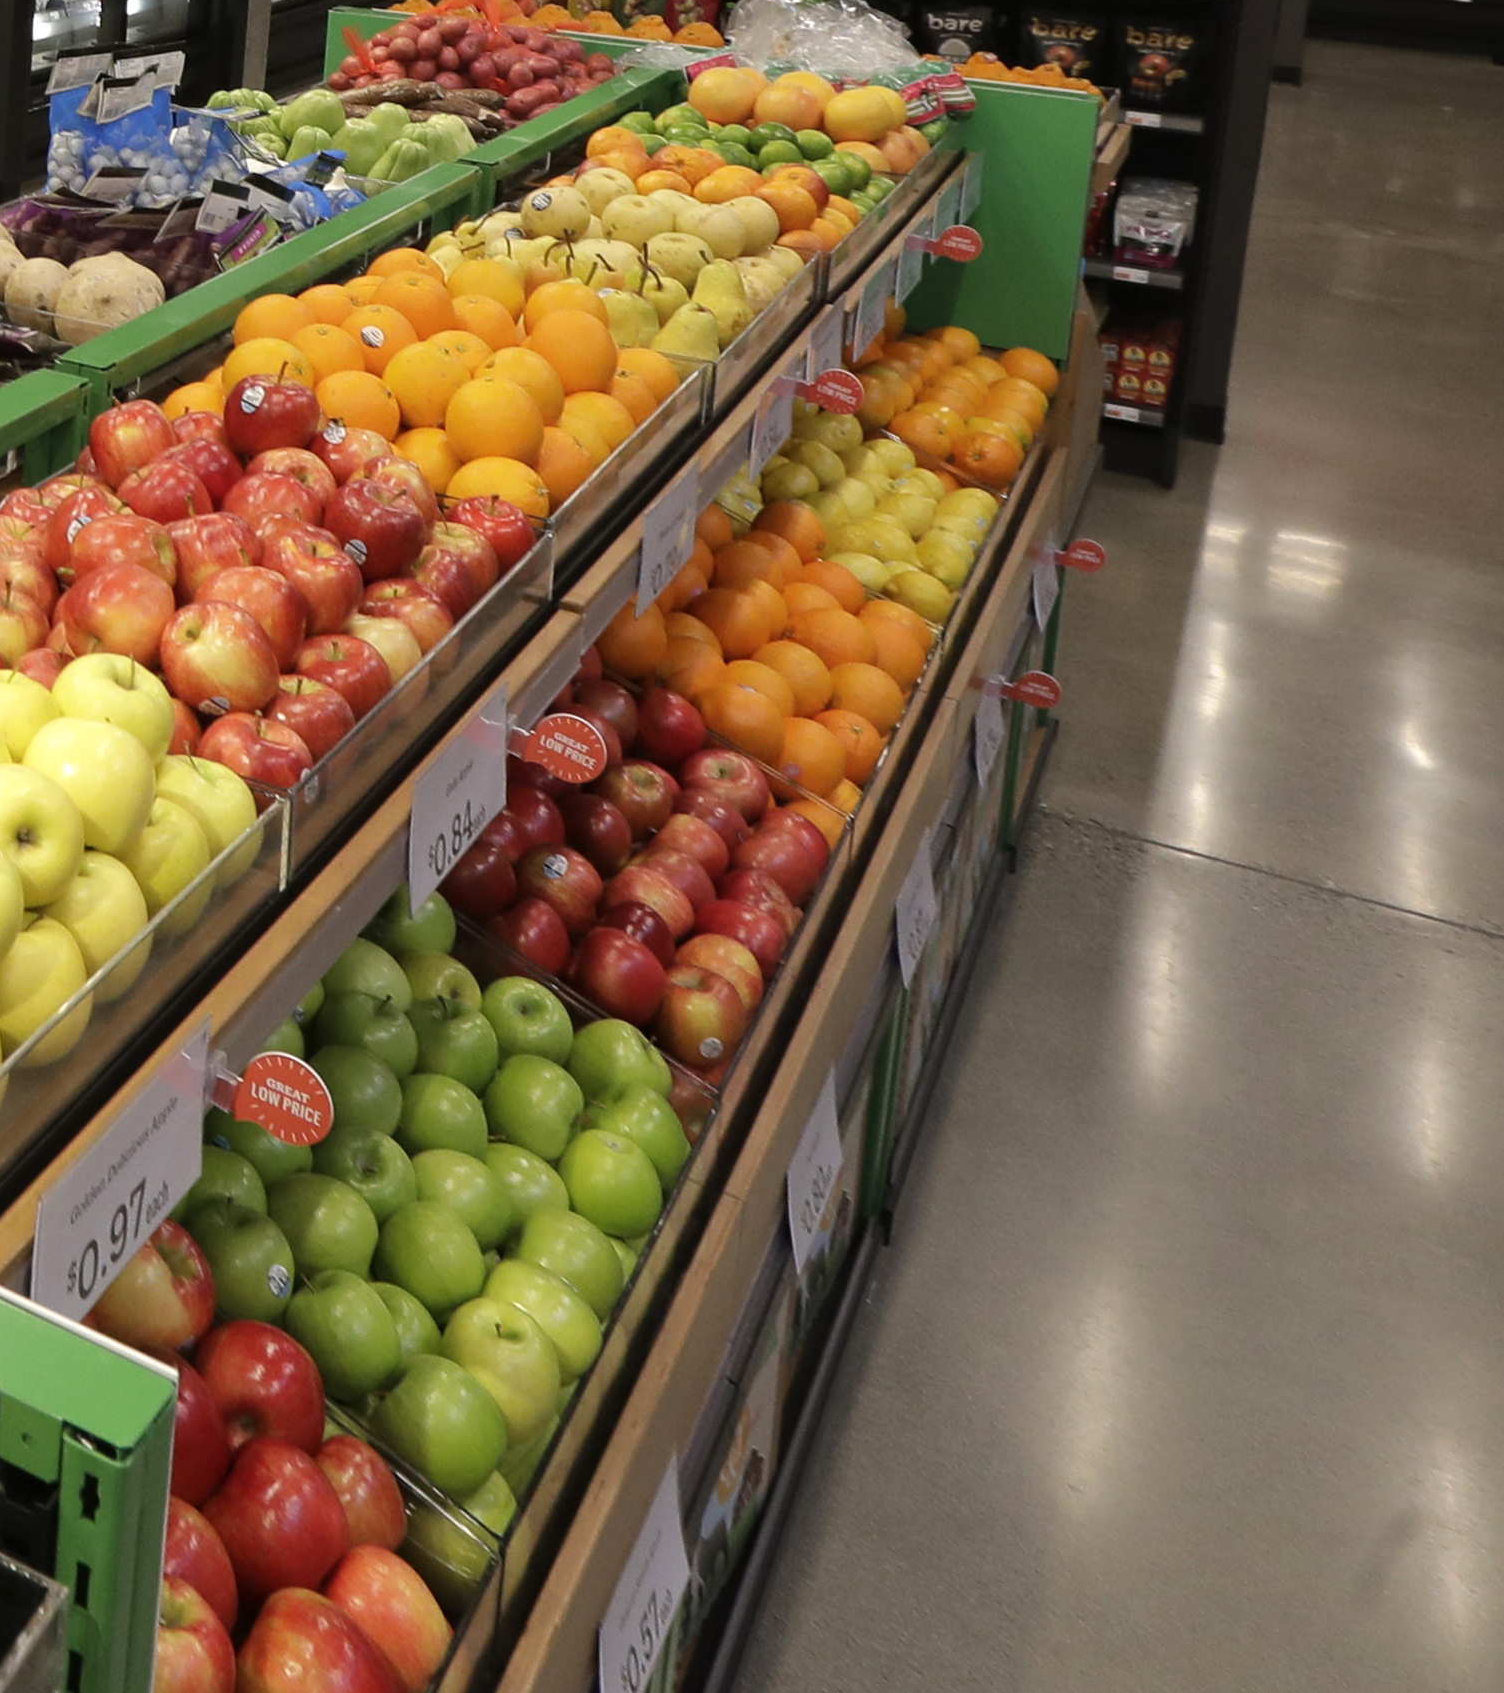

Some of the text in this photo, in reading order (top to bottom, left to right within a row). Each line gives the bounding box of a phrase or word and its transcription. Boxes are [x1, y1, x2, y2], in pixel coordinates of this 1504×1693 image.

[927, 13, 984, 33] bare
[539, 733, 598, 771] LOW PRICE
[553, 731, 590, 754] GREAT
[250, 1082, 323, 1128] LOW PRICE
[265, 1077, 311, 1104] GREAT
[66, 1176, 148, 1301] $0.97
